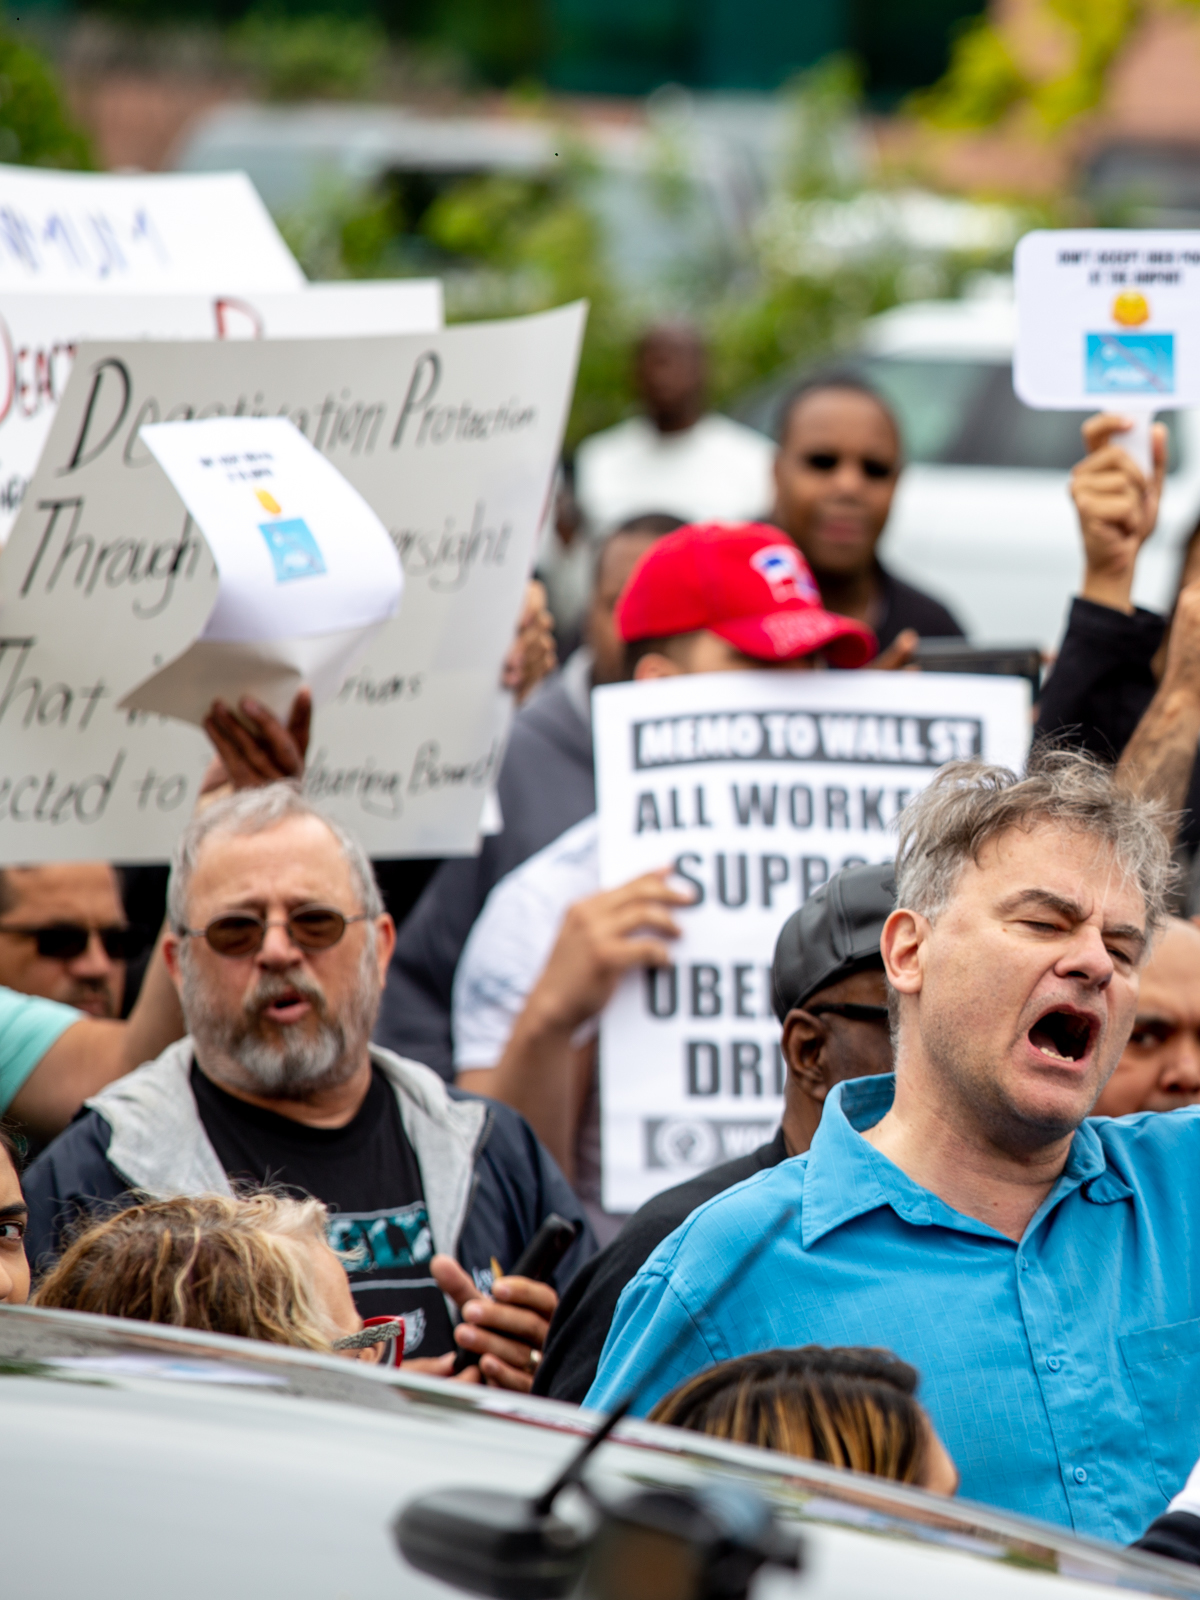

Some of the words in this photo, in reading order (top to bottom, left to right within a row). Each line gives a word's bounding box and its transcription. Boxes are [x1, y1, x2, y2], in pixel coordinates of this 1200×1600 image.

[638, 715, 764, 765] MEMO
[765, 714, 818, 761] TO
[819, 715, 926, 764] WALL
[927, 719, 978, 766] ST
[131, 765, 189, 811] to
[635, 786, 710, 835] ALL
[644, 964, 774, 1019] UBE
